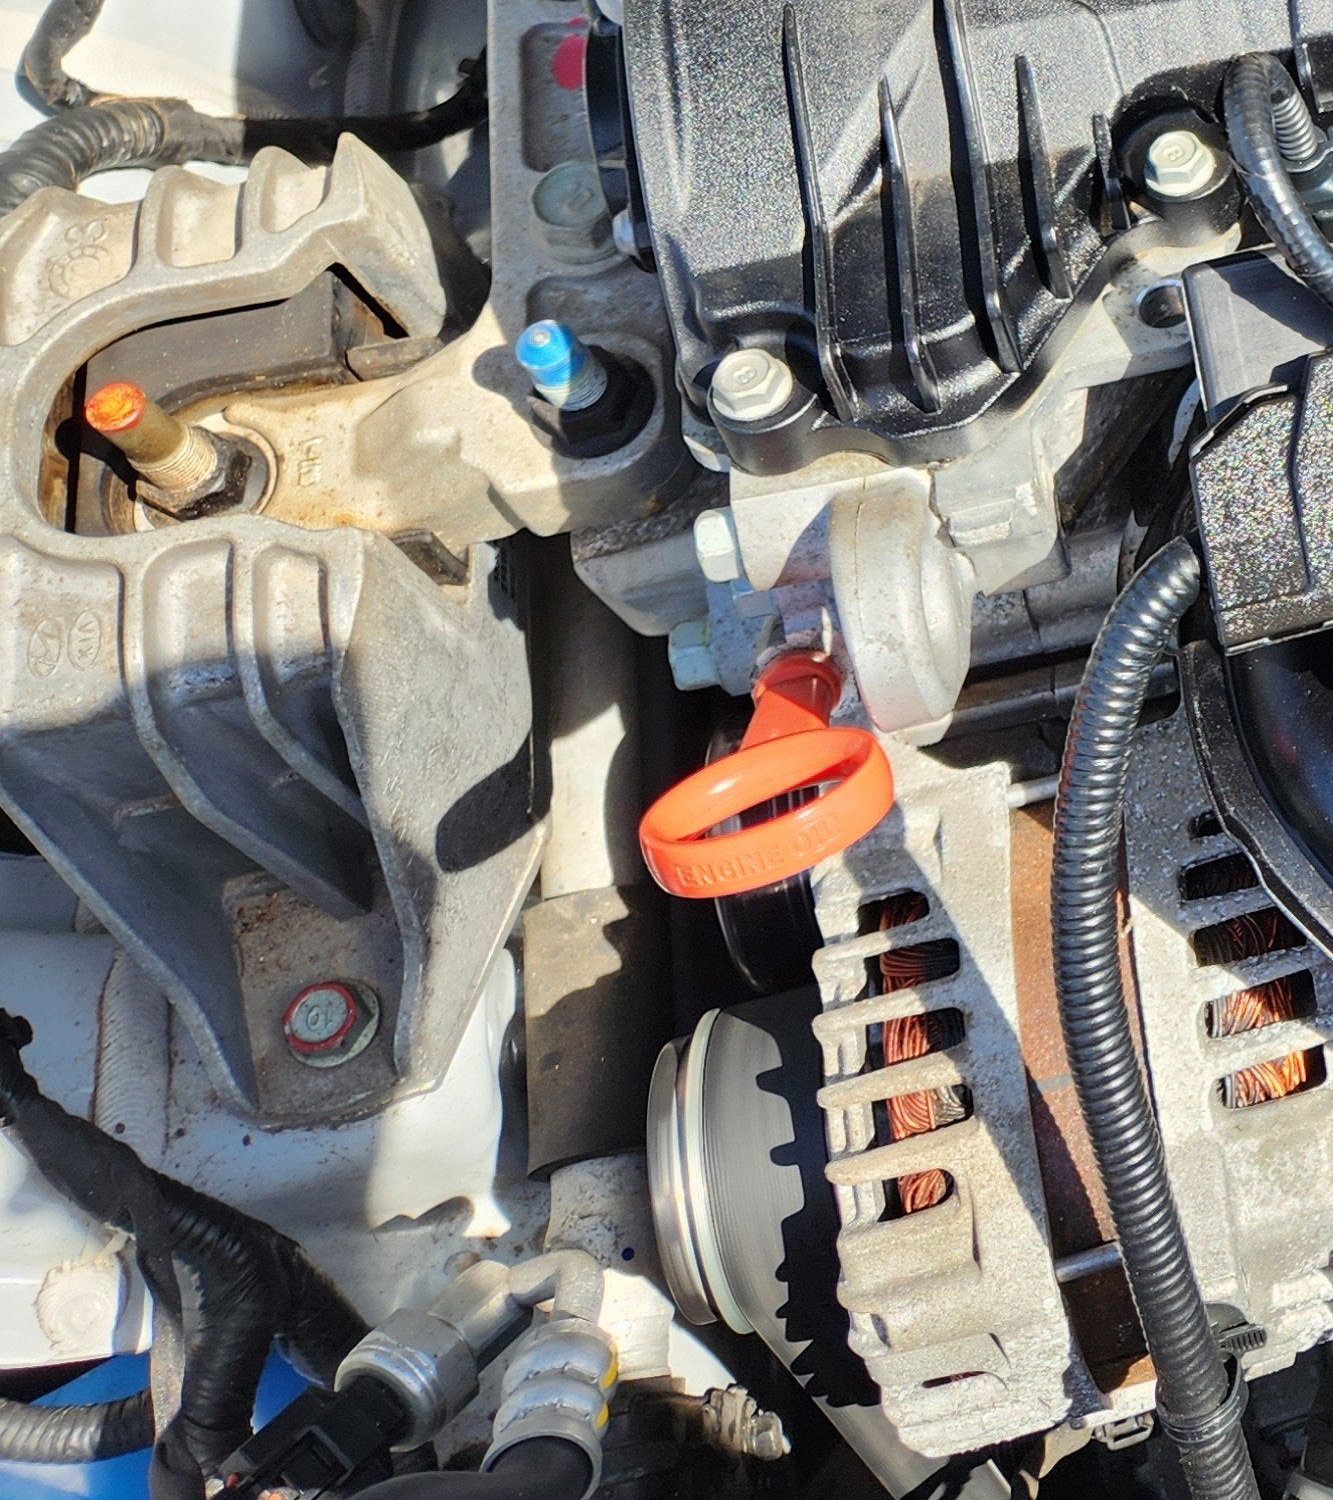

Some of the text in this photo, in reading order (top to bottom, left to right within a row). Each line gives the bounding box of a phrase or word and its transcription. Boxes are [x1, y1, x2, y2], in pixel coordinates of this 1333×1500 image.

[674, 812, 842, 888] ENGINE OIL
[305, 1000, 333, 1033] 10
